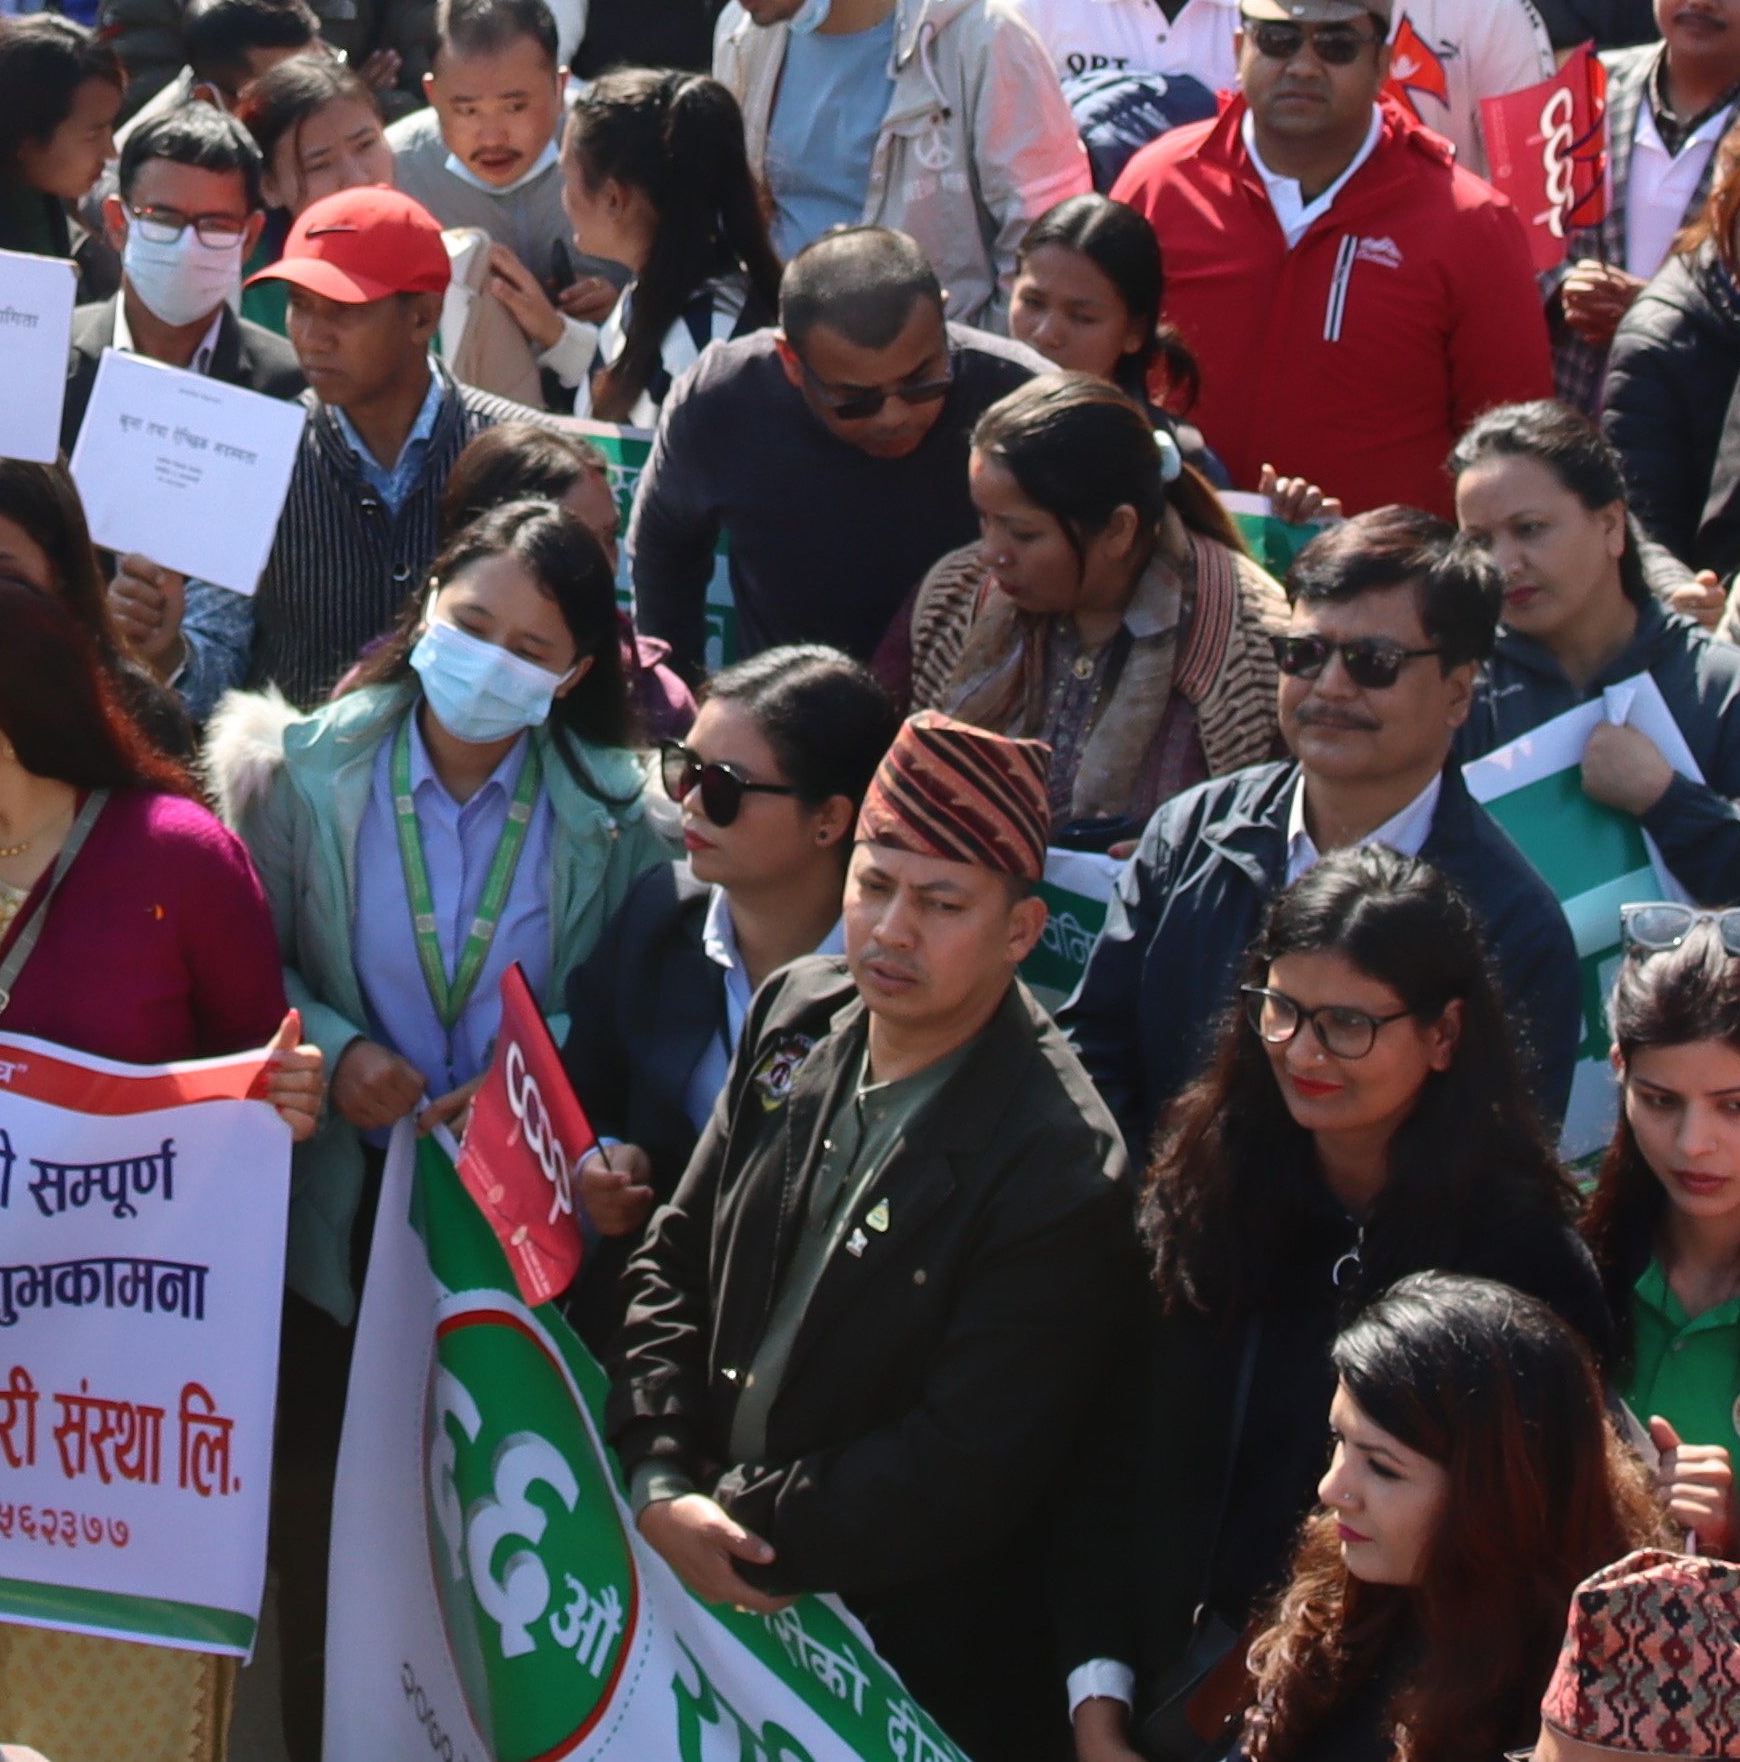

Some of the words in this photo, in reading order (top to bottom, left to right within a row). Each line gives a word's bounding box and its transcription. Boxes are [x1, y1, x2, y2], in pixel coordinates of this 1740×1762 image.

[27, 1138, 177, 1219] सम्पूर्ण
[52, 1377, 166, 1486] संस्था
[177, 1380, 242, 1498] लि.
